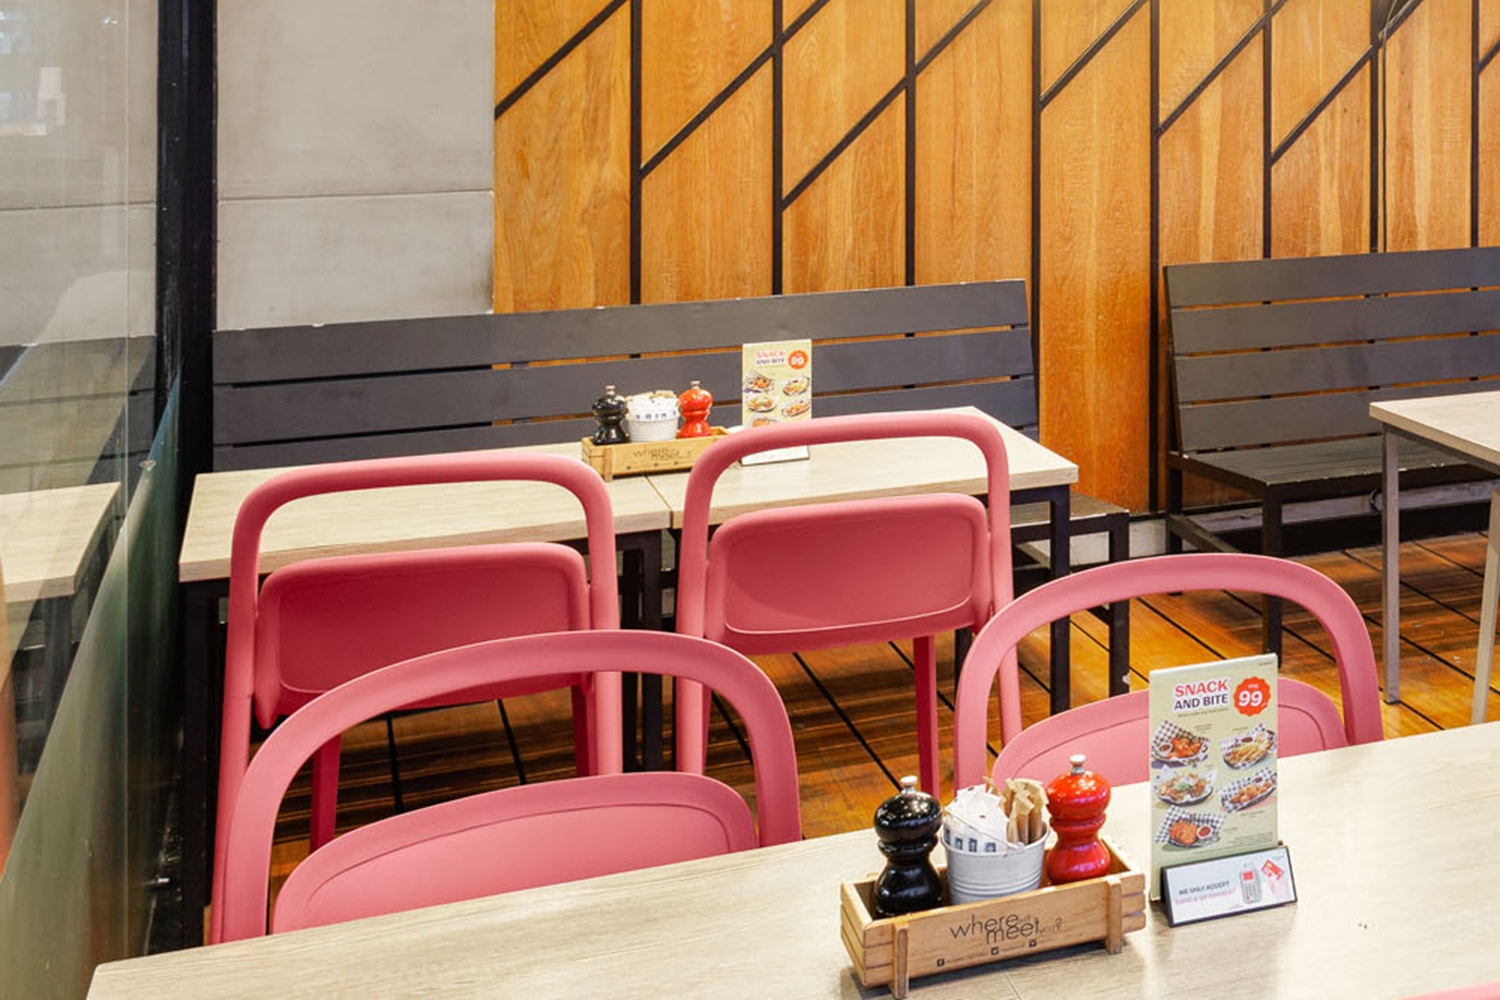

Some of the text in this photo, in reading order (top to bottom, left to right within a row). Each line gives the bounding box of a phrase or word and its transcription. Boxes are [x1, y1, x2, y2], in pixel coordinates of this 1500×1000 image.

[1175, 678, 1228, 698] SNACK
[1174, 693, 1229, 711] AND BITE
[949, 914, 1019, 939] where
[986, 917, 1039, 945] meet
